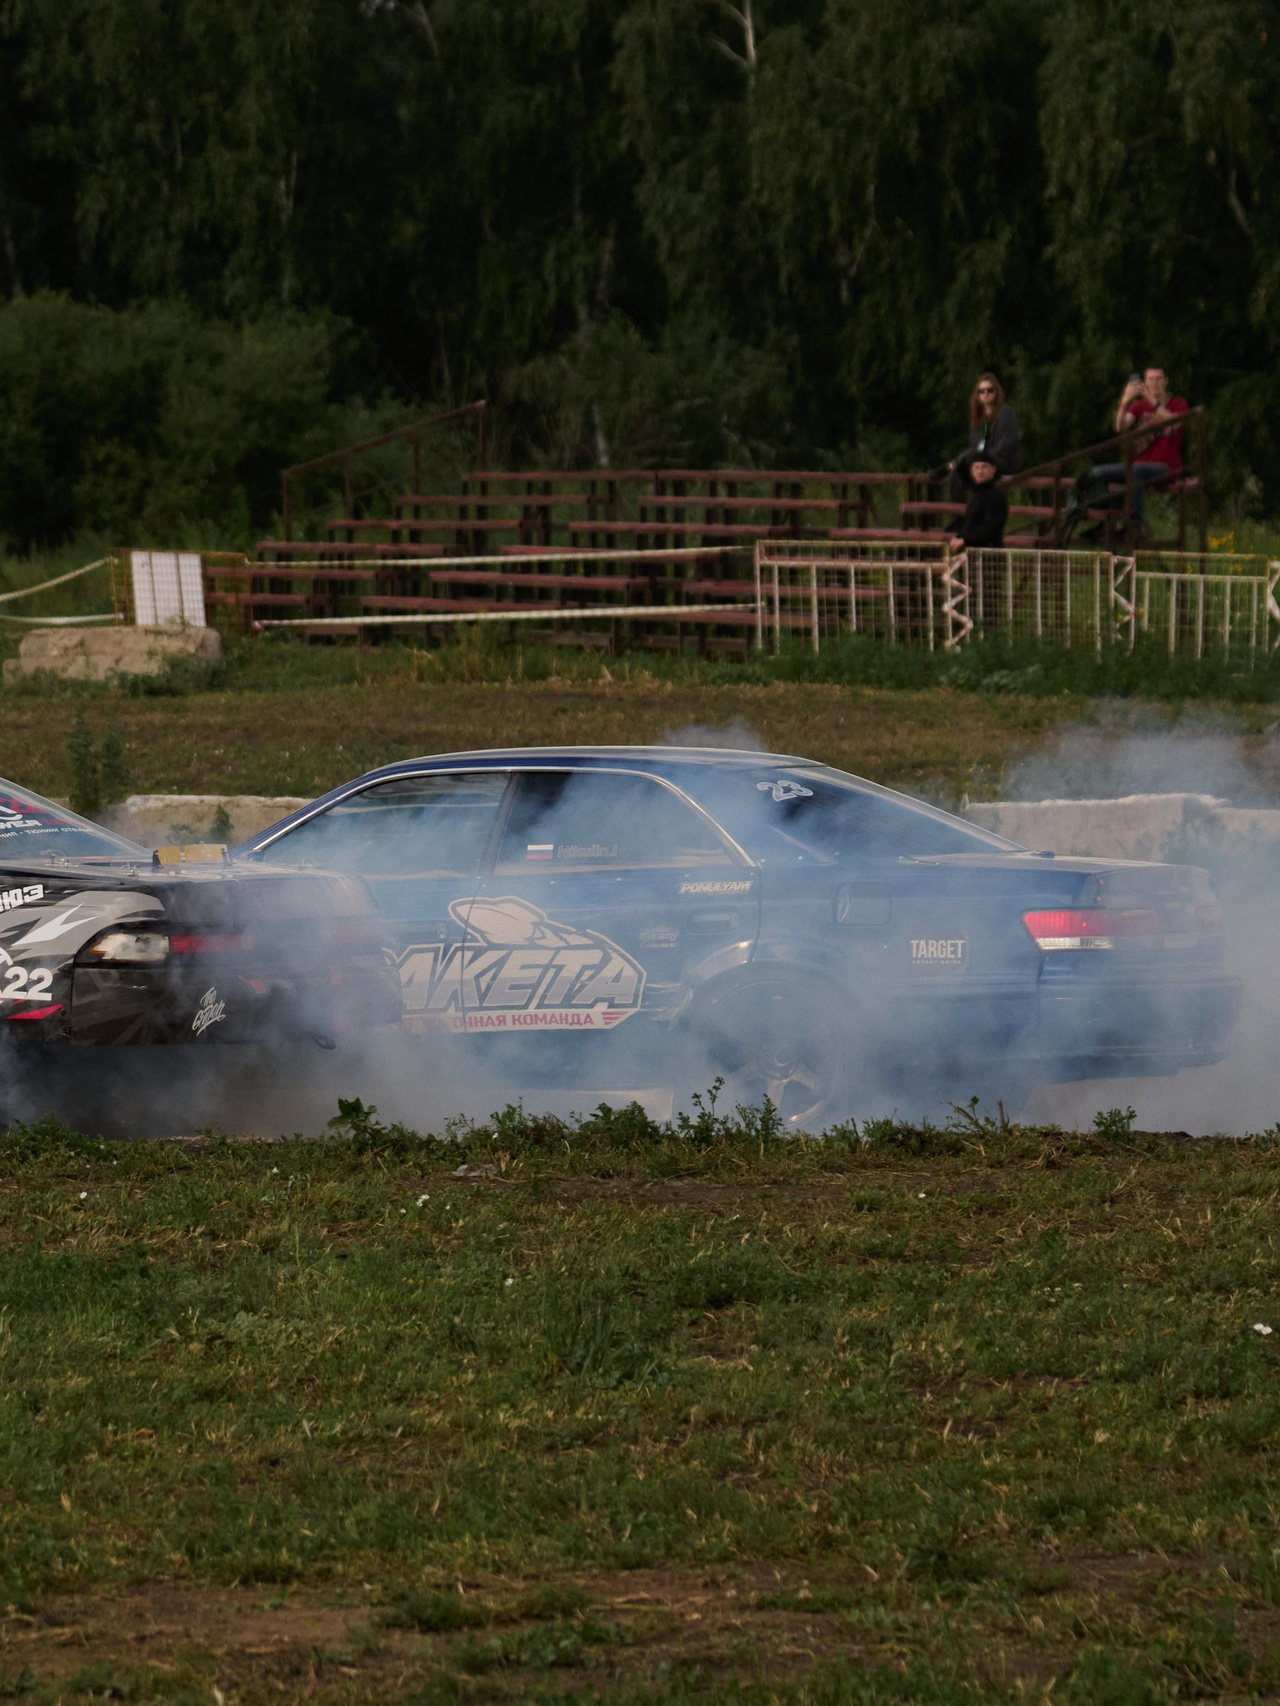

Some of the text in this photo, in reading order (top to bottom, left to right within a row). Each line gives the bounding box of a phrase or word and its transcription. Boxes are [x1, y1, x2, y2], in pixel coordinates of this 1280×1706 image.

[756, 780, 814, 802] 23
[679, 880, 751, 894] PONULYAM
[909, 939, 965, 959] TARGET
[388, 943, 646, 1012] АКЕТА
[511, 1012, 595, 1028] КОМАНДА
